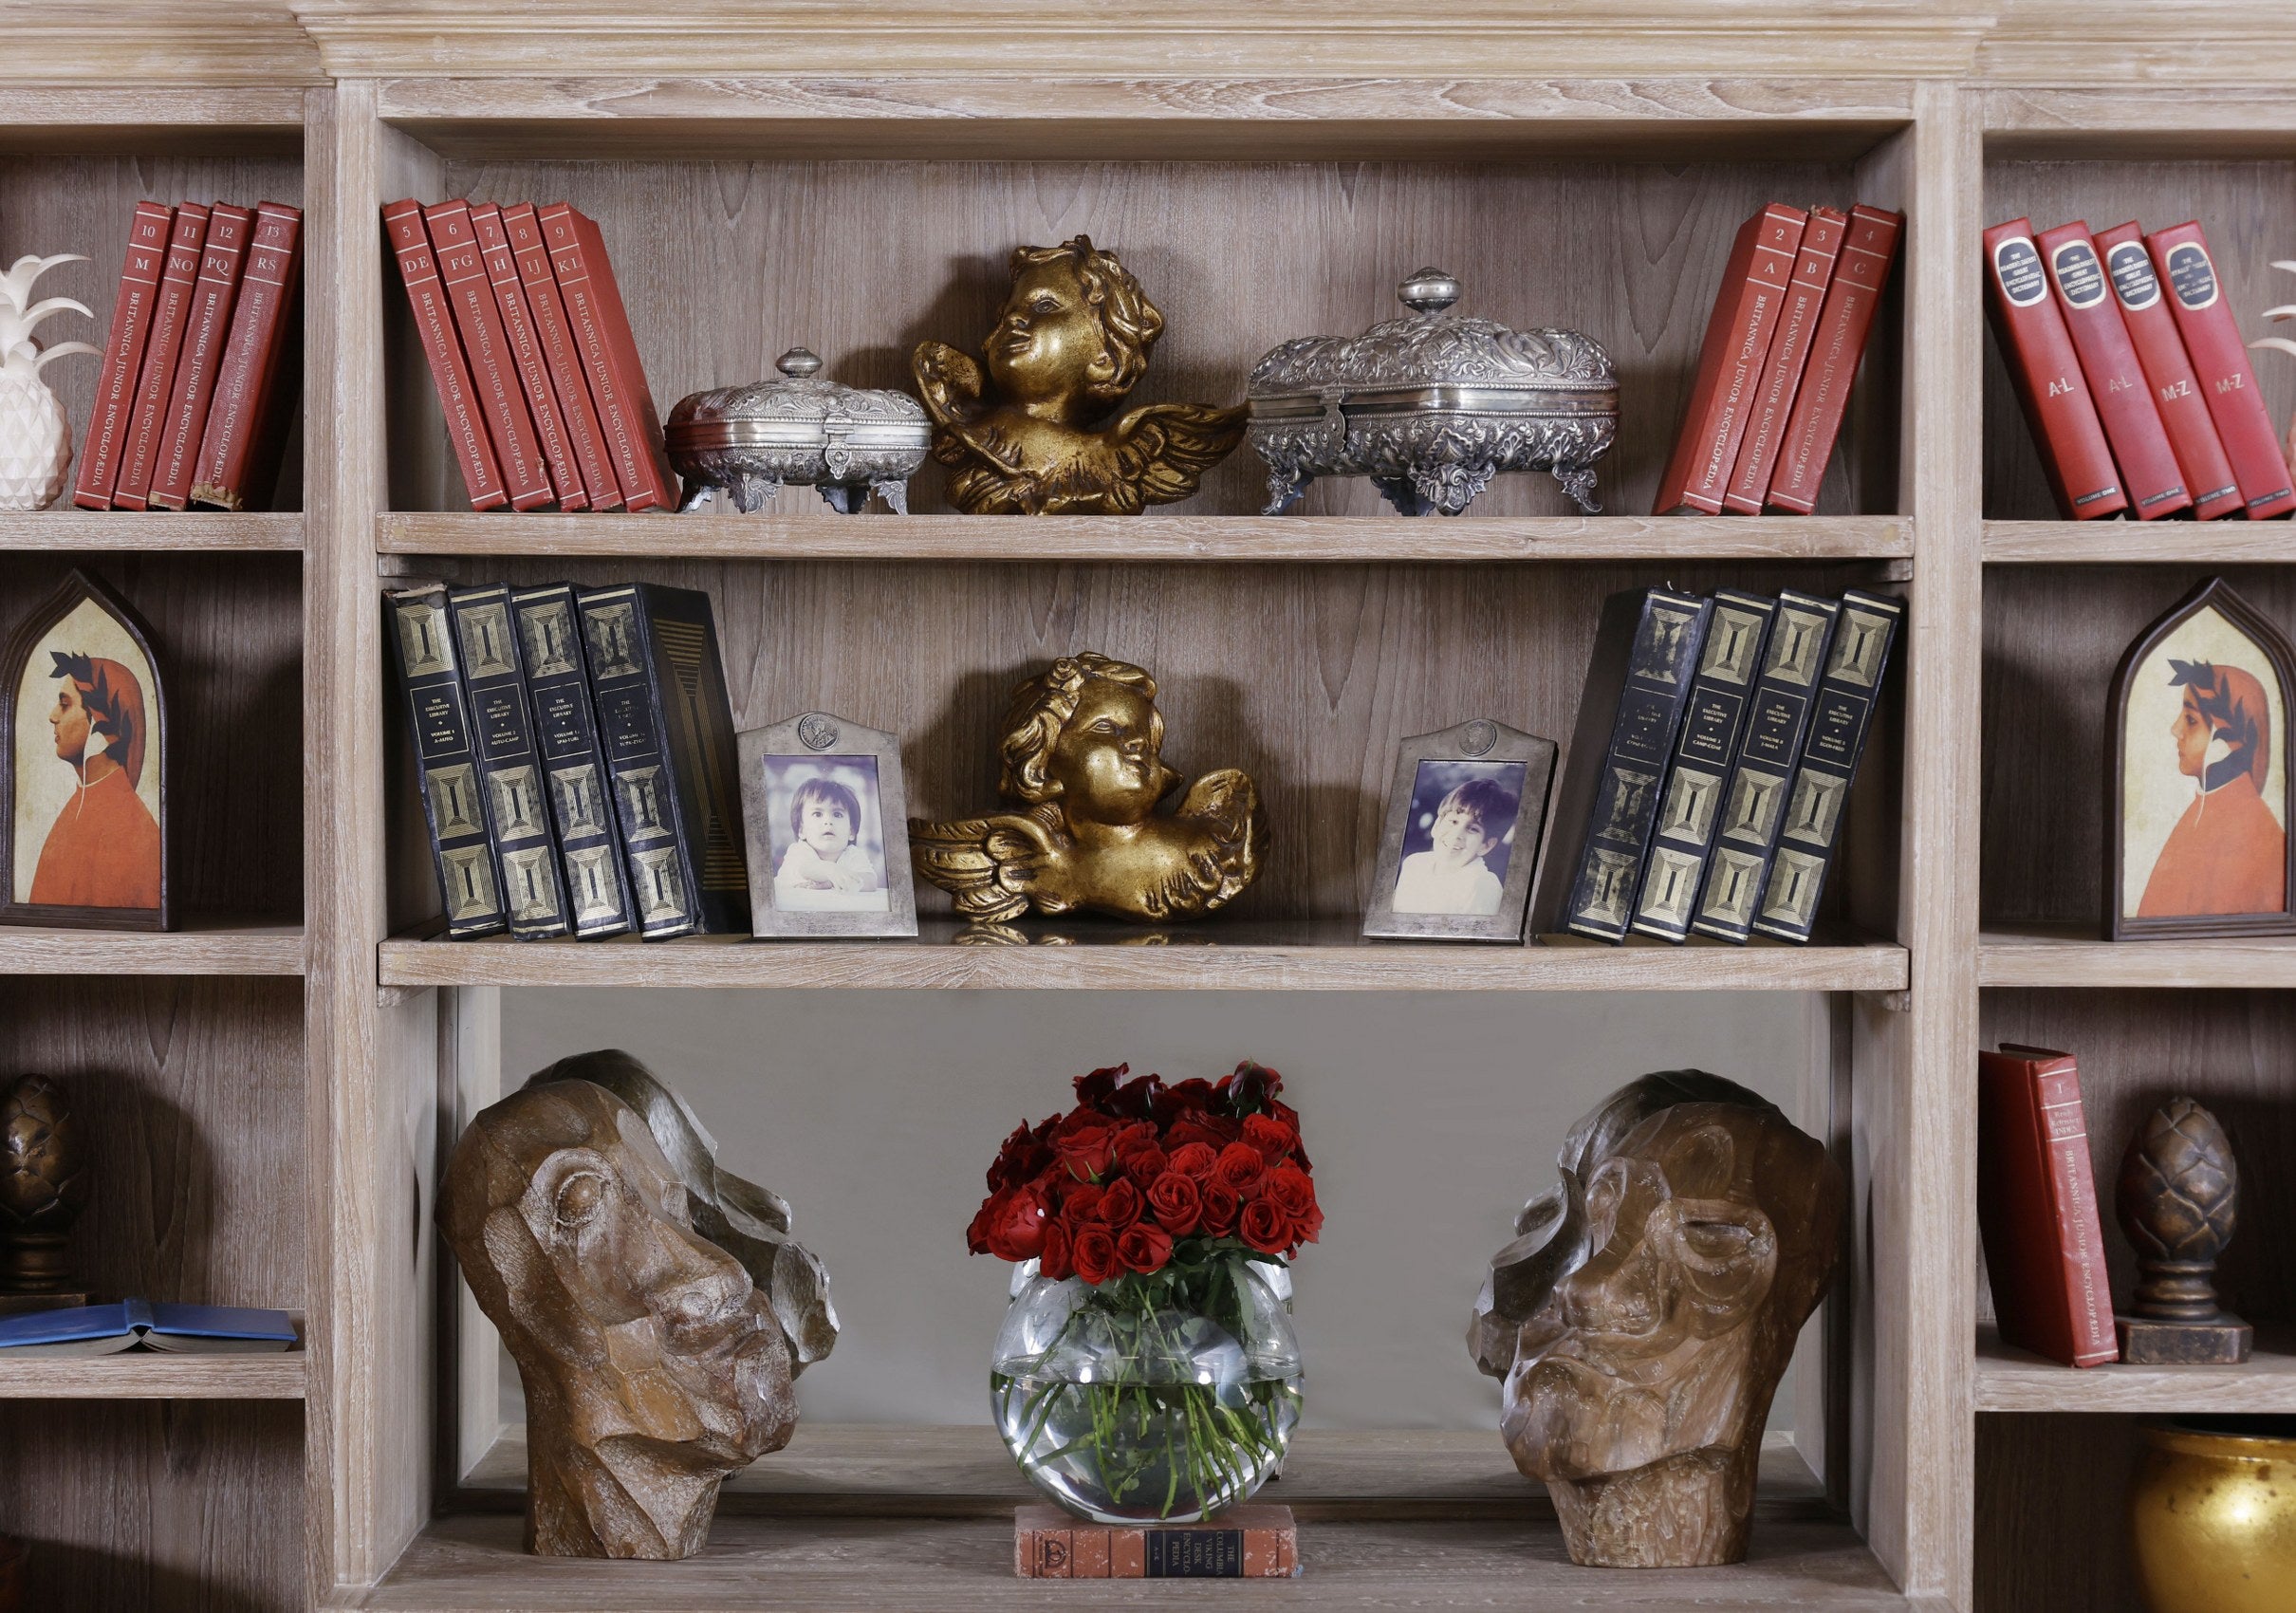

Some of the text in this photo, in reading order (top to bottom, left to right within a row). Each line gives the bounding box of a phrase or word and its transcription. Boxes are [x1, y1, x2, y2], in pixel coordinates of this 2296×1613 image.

[141, 225, 156, 238] 10
[184, 226, 195, 239] 11
[219, 226, 232, 238] 12
[267, 226, 279, 237] 13
[402, 226, 411, 238] 5
[449, 224, 457, 234] 6
[486, 226, 492, 238] 7
[519, 228, 528, 240] 8
[556, 227, 565, 238] 9
[1775, 229, 1784, 240] 2
[1817, 230, 1825, 241] 3
[1867, 231, 1874, 241] 4
[135, 258, 148, 269] M
[170, 257, 194, 272] NO
[207, 257, 229, 277] PQ
[257, 258, 276, 270] RS
[404, 256, 429, 273] DE
[451, 254, 473, 269] FG
[494, 260, 507, 271] H
[527, 260, 541, 274] IJ
[1765, 263, 1775, 273] A
[1806, 263, 1816, 273] B
[1855, 263, 1865, 274] C
[2012, 280, 2039, 293] DICTIONARY
[2070, 283, 2099, 295] DICTIONARY
[2125, 284, 2152, 297] DICTIONARY
[93, 292, 139, 486] BRITANNICA JUNIOR ENCYCLOPÆDIA
[130, 292, 178, 486] BRITANNICA JUNIOR ENCYCLOPÆDIA
[167, 293, 216, 486] BRITANNICA JUNIOR ENCYCLOPÆDIA
[213, 292, 263, 484] BRITANNICA JUNIOR ENCYCLOPÆDIA
[421, 292, 487, 488] BRITANNICA JUNIOR ENCYCLOPÆDIA
[467, 290, 528, 486] BRITANNICA JUNIOR ENCYCLOPÆDIA
[506, 292, 569, 487] BRITANNICA JUNIOR ENCYCLOPÆDIA
[538, 293, 602, 488] BRITANNICA JUNIOR ENCYCLOPÆDIA
[575, 292, 638, 487] BRITANNICA JUNIOR ENCYCLOPÆDIA
[2049, 377, 2074, 398] A-L
[2108, 375, 2133, 394] A-L
[2162, 380, 2191, 401] M-Z
[2215, 373, 2245, 395] M-Z
[1703, 295, 1766, 489] BRITANNICA JUNIOR ENCYCLOPÆDIA
[1743, 296, 1806, 490] BRITANNICA JUNIOR ENCYCLOPÆDIA
[1790, 296, 1855, 489] BRITANNICA JUNIOR ENCYCLOPÆDIA
[2077, 487, 2116, 504] VOLUME ONE
[2141, 488, 2180, 505] VOLUME ONE
[2222, 486, 2236, 495] TWO
[1703, 709, 1727, 717] EXECUTIVE
[1767, 710, 1790, 718] EXECUTIVE
[1829, 711, 1853, 719] EXECUTIVE
[1760, 734, 1779, 744] VOLUME
[1822, 735, 1842, 744] VOLUME
[2065, 1150, 2099, 1345] BRITANNICA JUNIOR ENCYCLOPÆDIA
